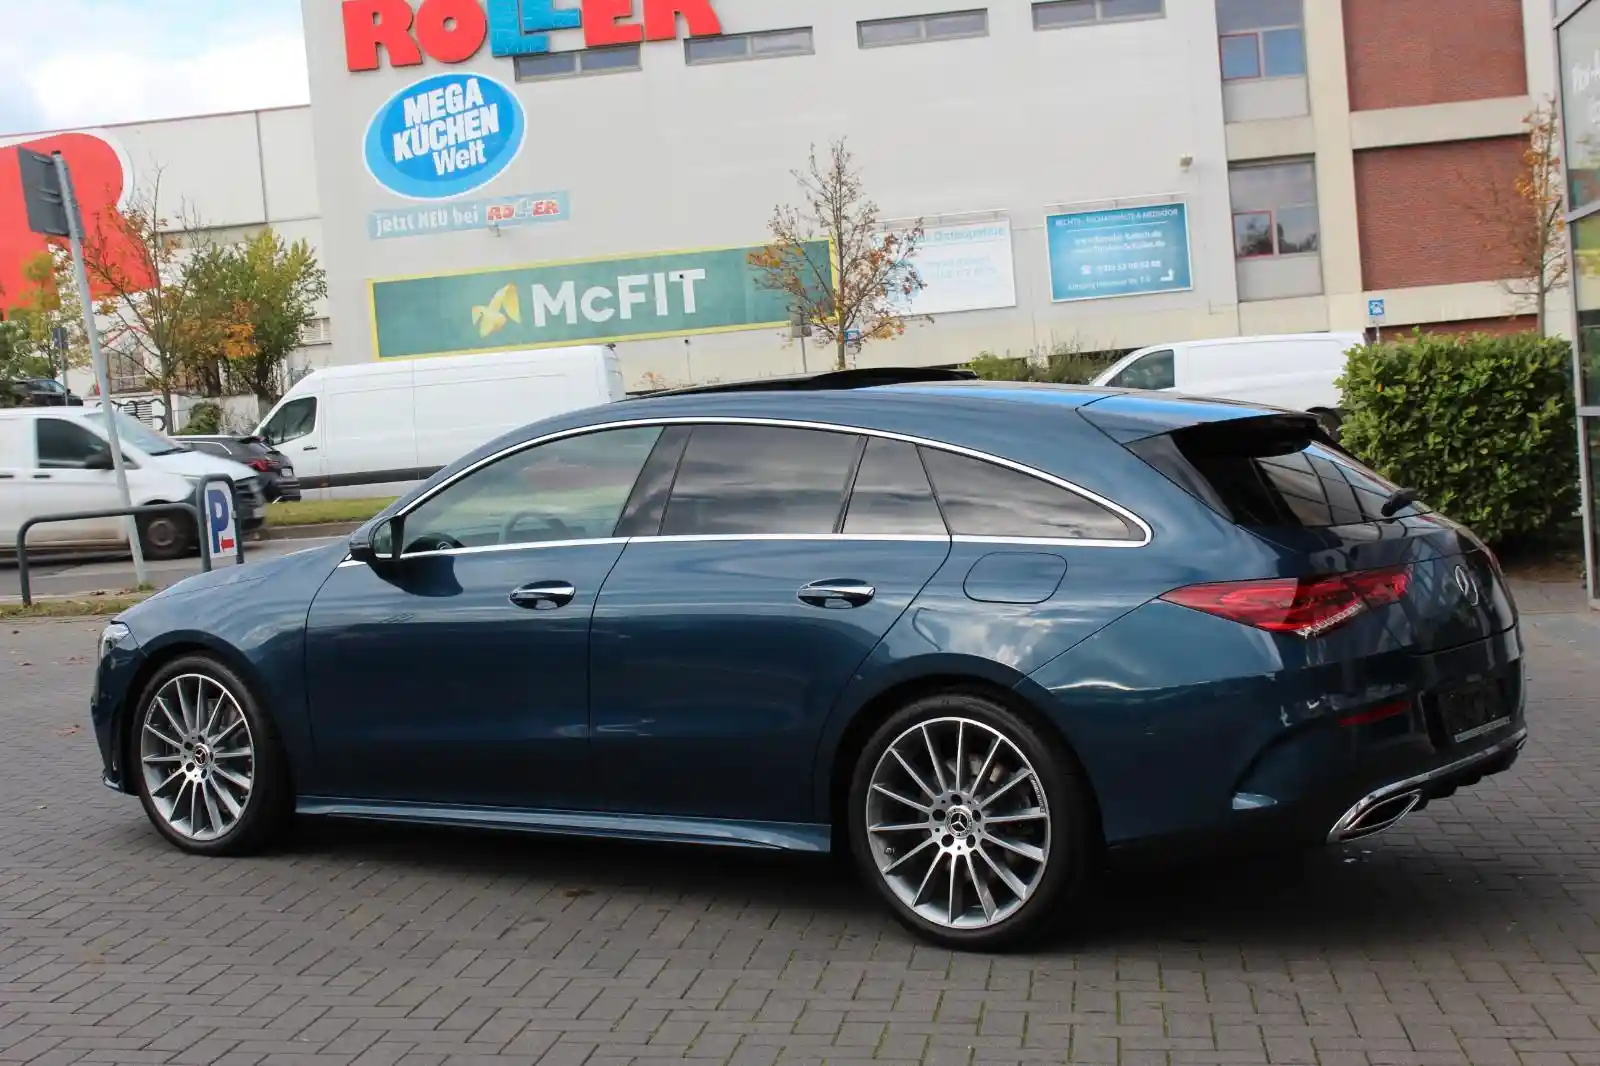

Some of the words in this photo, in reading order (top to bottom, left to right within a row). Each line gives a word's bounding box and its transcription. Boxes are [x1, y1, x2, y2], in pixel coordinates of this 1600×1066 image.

[403, 77, 485, 128] MEGA
[392, 103, 500, 164] KÜCHEN
[432, 140, 488, 176] Welt
[376, 212, 416, 237] jetzt
[418, 207, 448, 229] NEU
[452, 205, 479, 224] bei
[531, 268, 706, 327] McFIT
[207, 489, 229, 553] P
